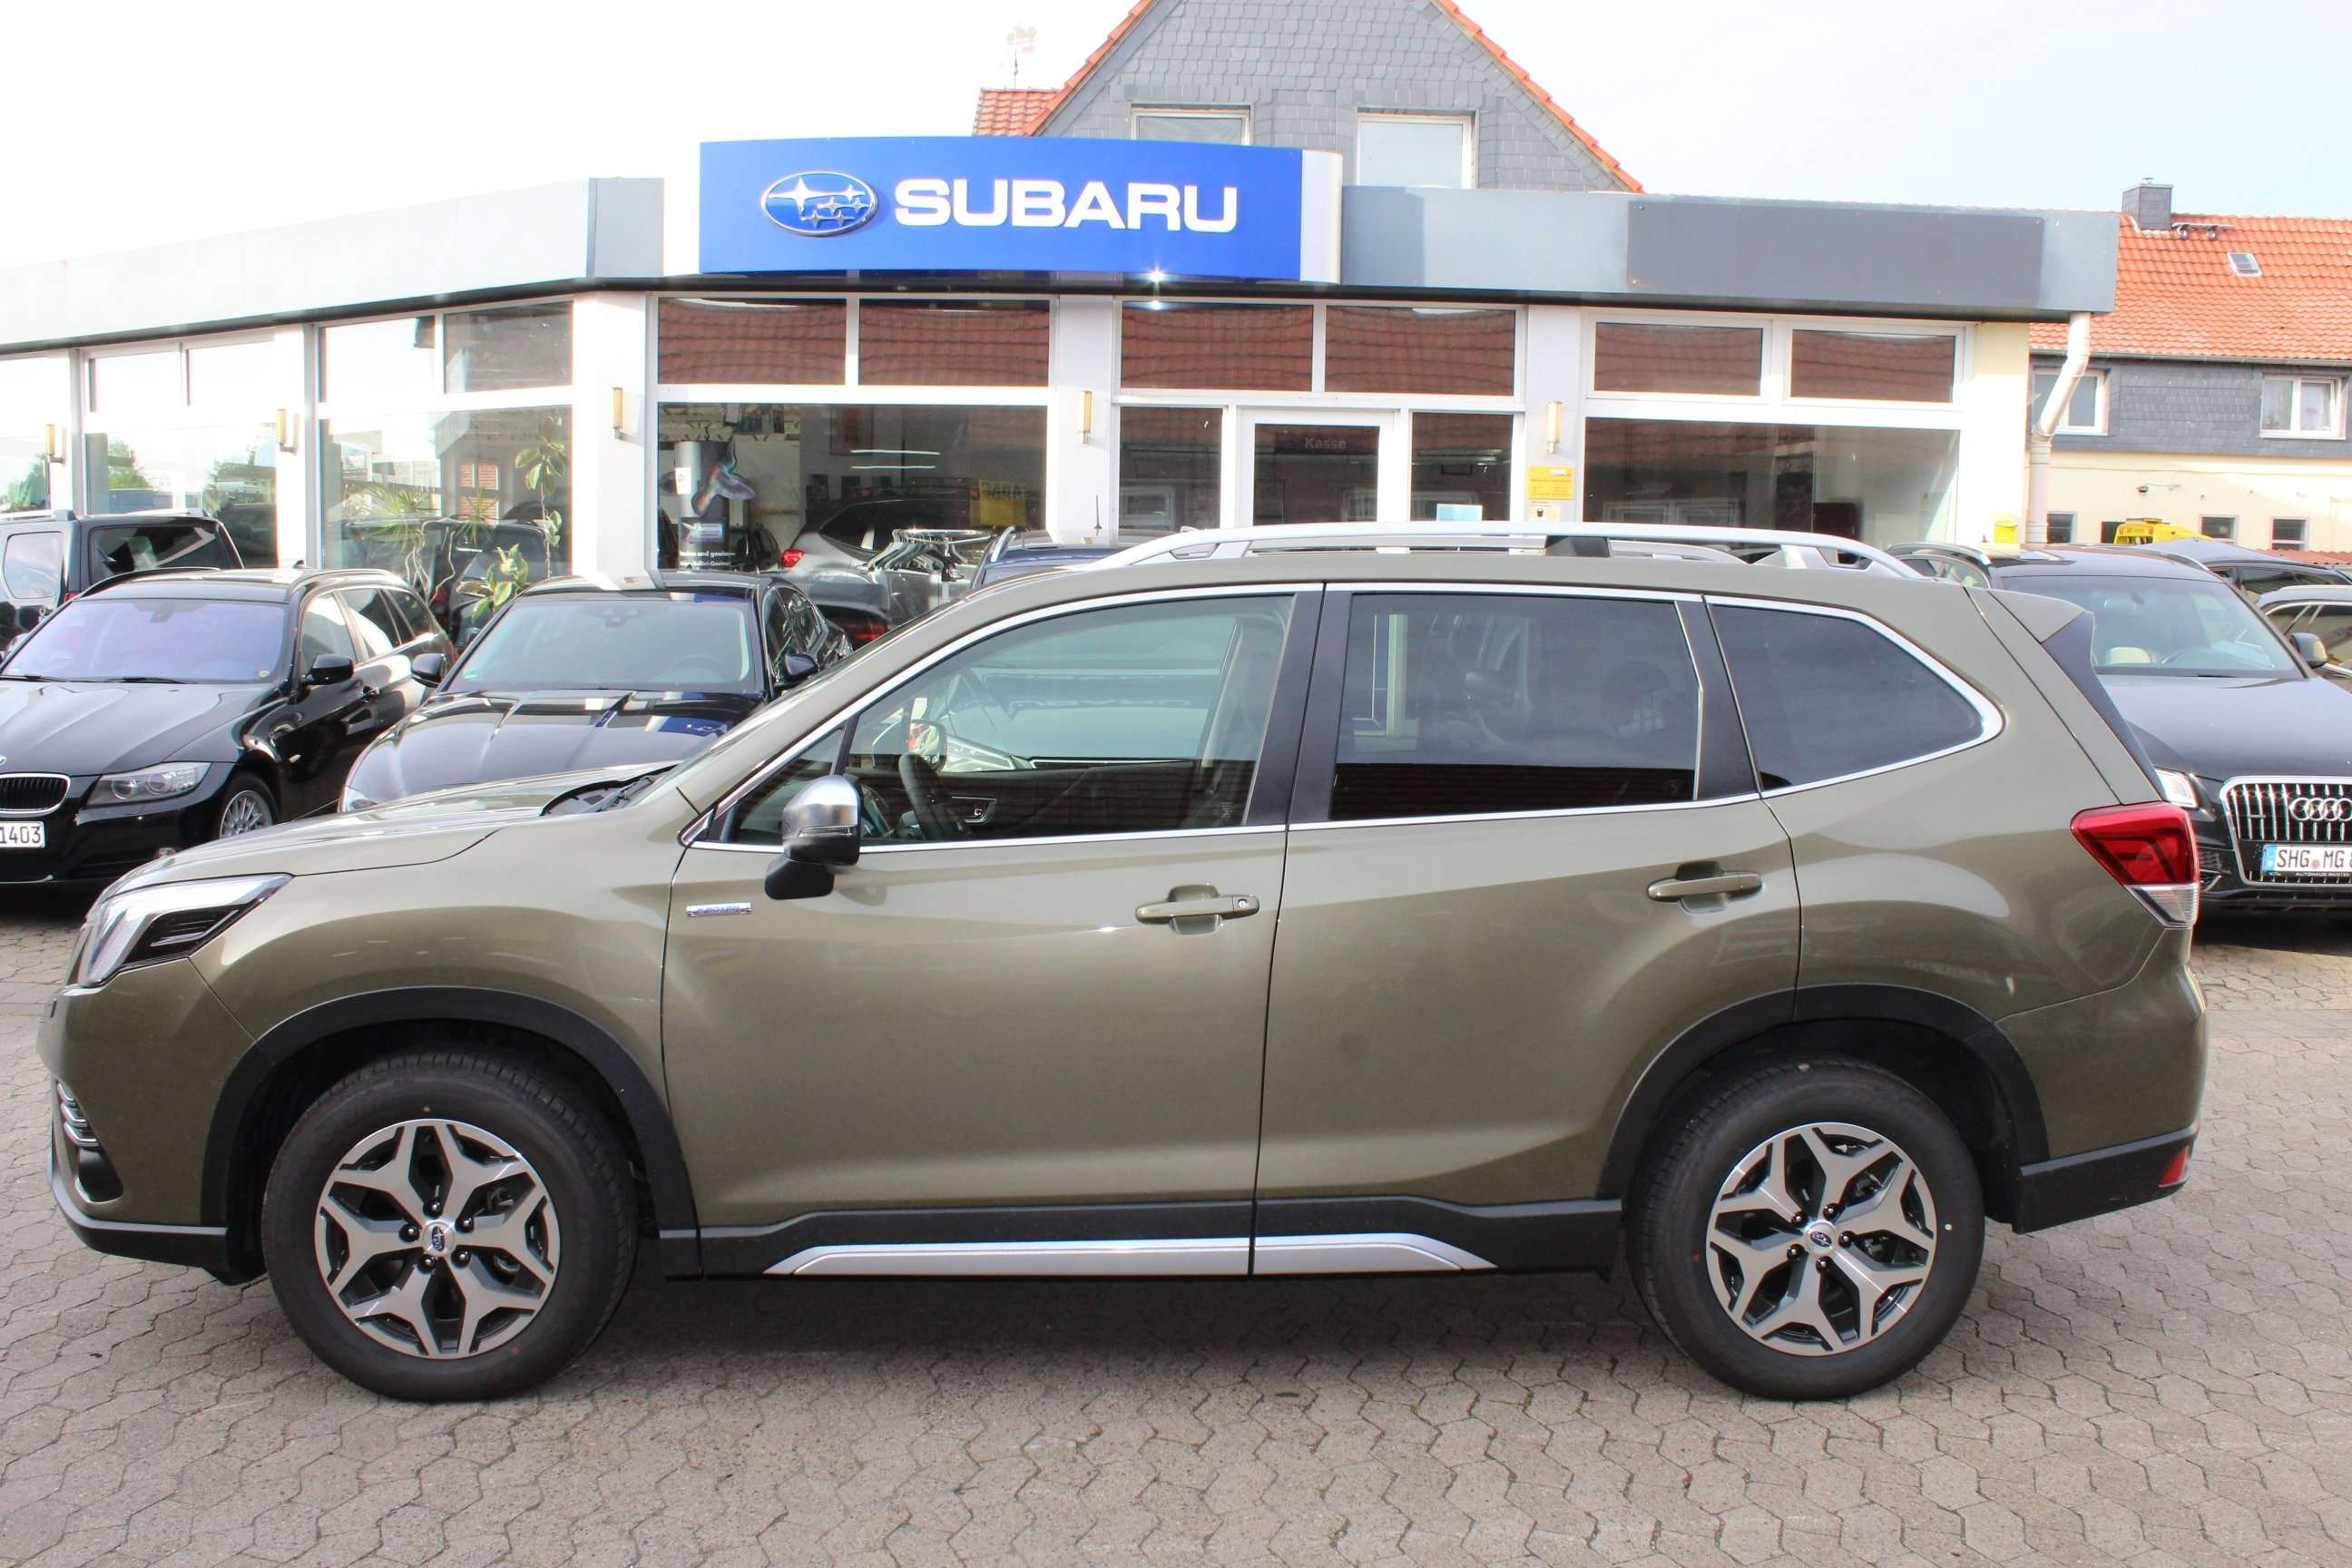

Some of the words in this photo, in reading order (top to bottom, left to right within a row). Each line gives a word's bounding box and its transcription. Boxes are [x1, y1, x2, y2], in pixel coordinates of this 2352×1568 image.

[894, 178, 1238, 232] SUBARU
[1306, 436, 1347, 449] Kasse
[0, 826, 42, 844] 1403
[2277, 849, 2310, 868] SHG
[2323, 850, 2345, 868] MG
